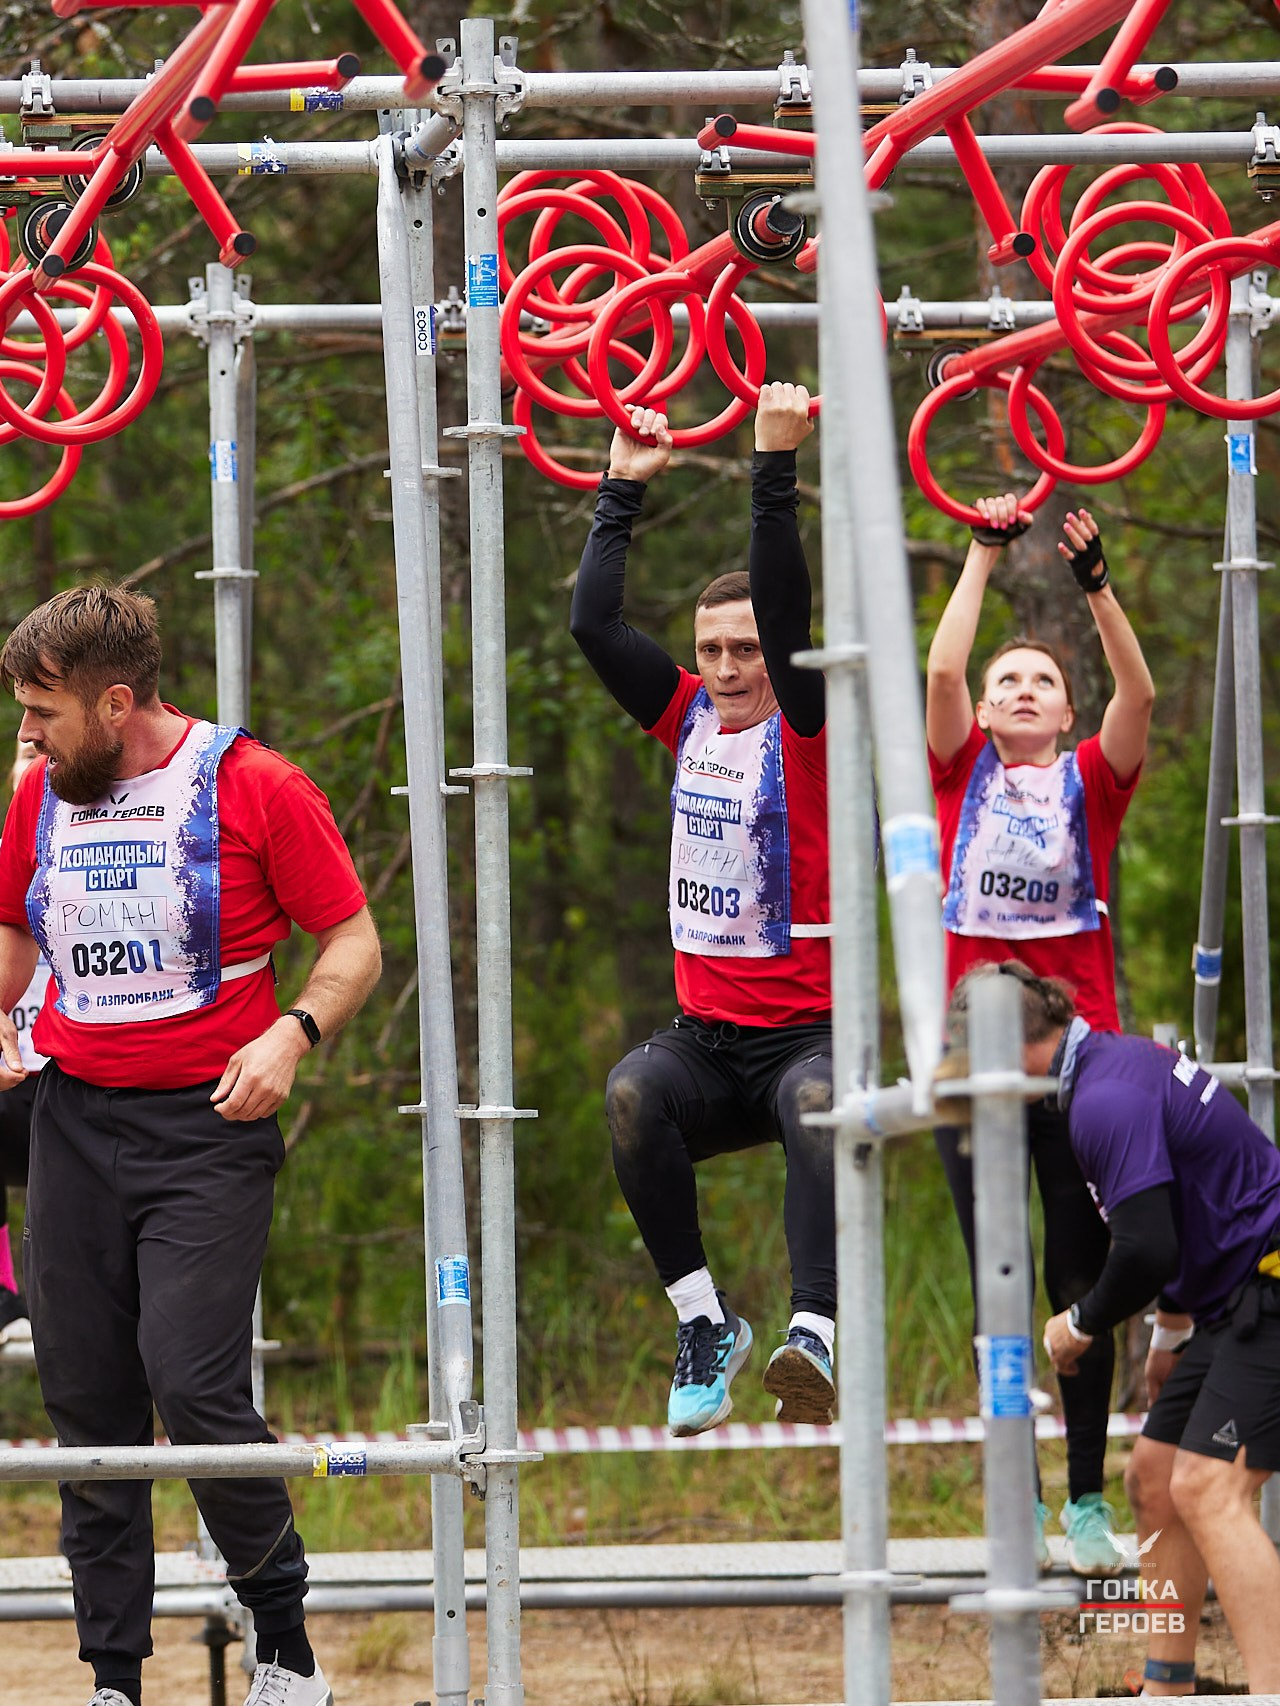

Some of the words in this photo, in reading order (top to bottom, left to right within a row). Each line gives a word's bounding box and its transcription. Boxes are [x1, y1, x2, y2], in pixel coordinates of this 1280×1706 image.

[416, 311, 428, 350] СОЮЗ
[71, 808, 108, 822] ГОНКА
[113, 805, 165, 818] ГЕРОЕВ
[689, 817, 720, 838] СТАРТ
[61, 841, 164, 868] КОМАНДНЫЙ
[678, 843, 738, 873] РУСЛАН
[88, 868, 134, 889] СТАРТ
[980, 871, 1059, 903] 03209
[678, 878, 740, 919] 03203
[62, 901, 156, 932] РОМАН
[688, 929, 745, 945] ГАЗПРОМБАНК
[72, 940, 164, 977] 03201
[97, 989, 174, 1007] ГАЗПРОМБАНК
